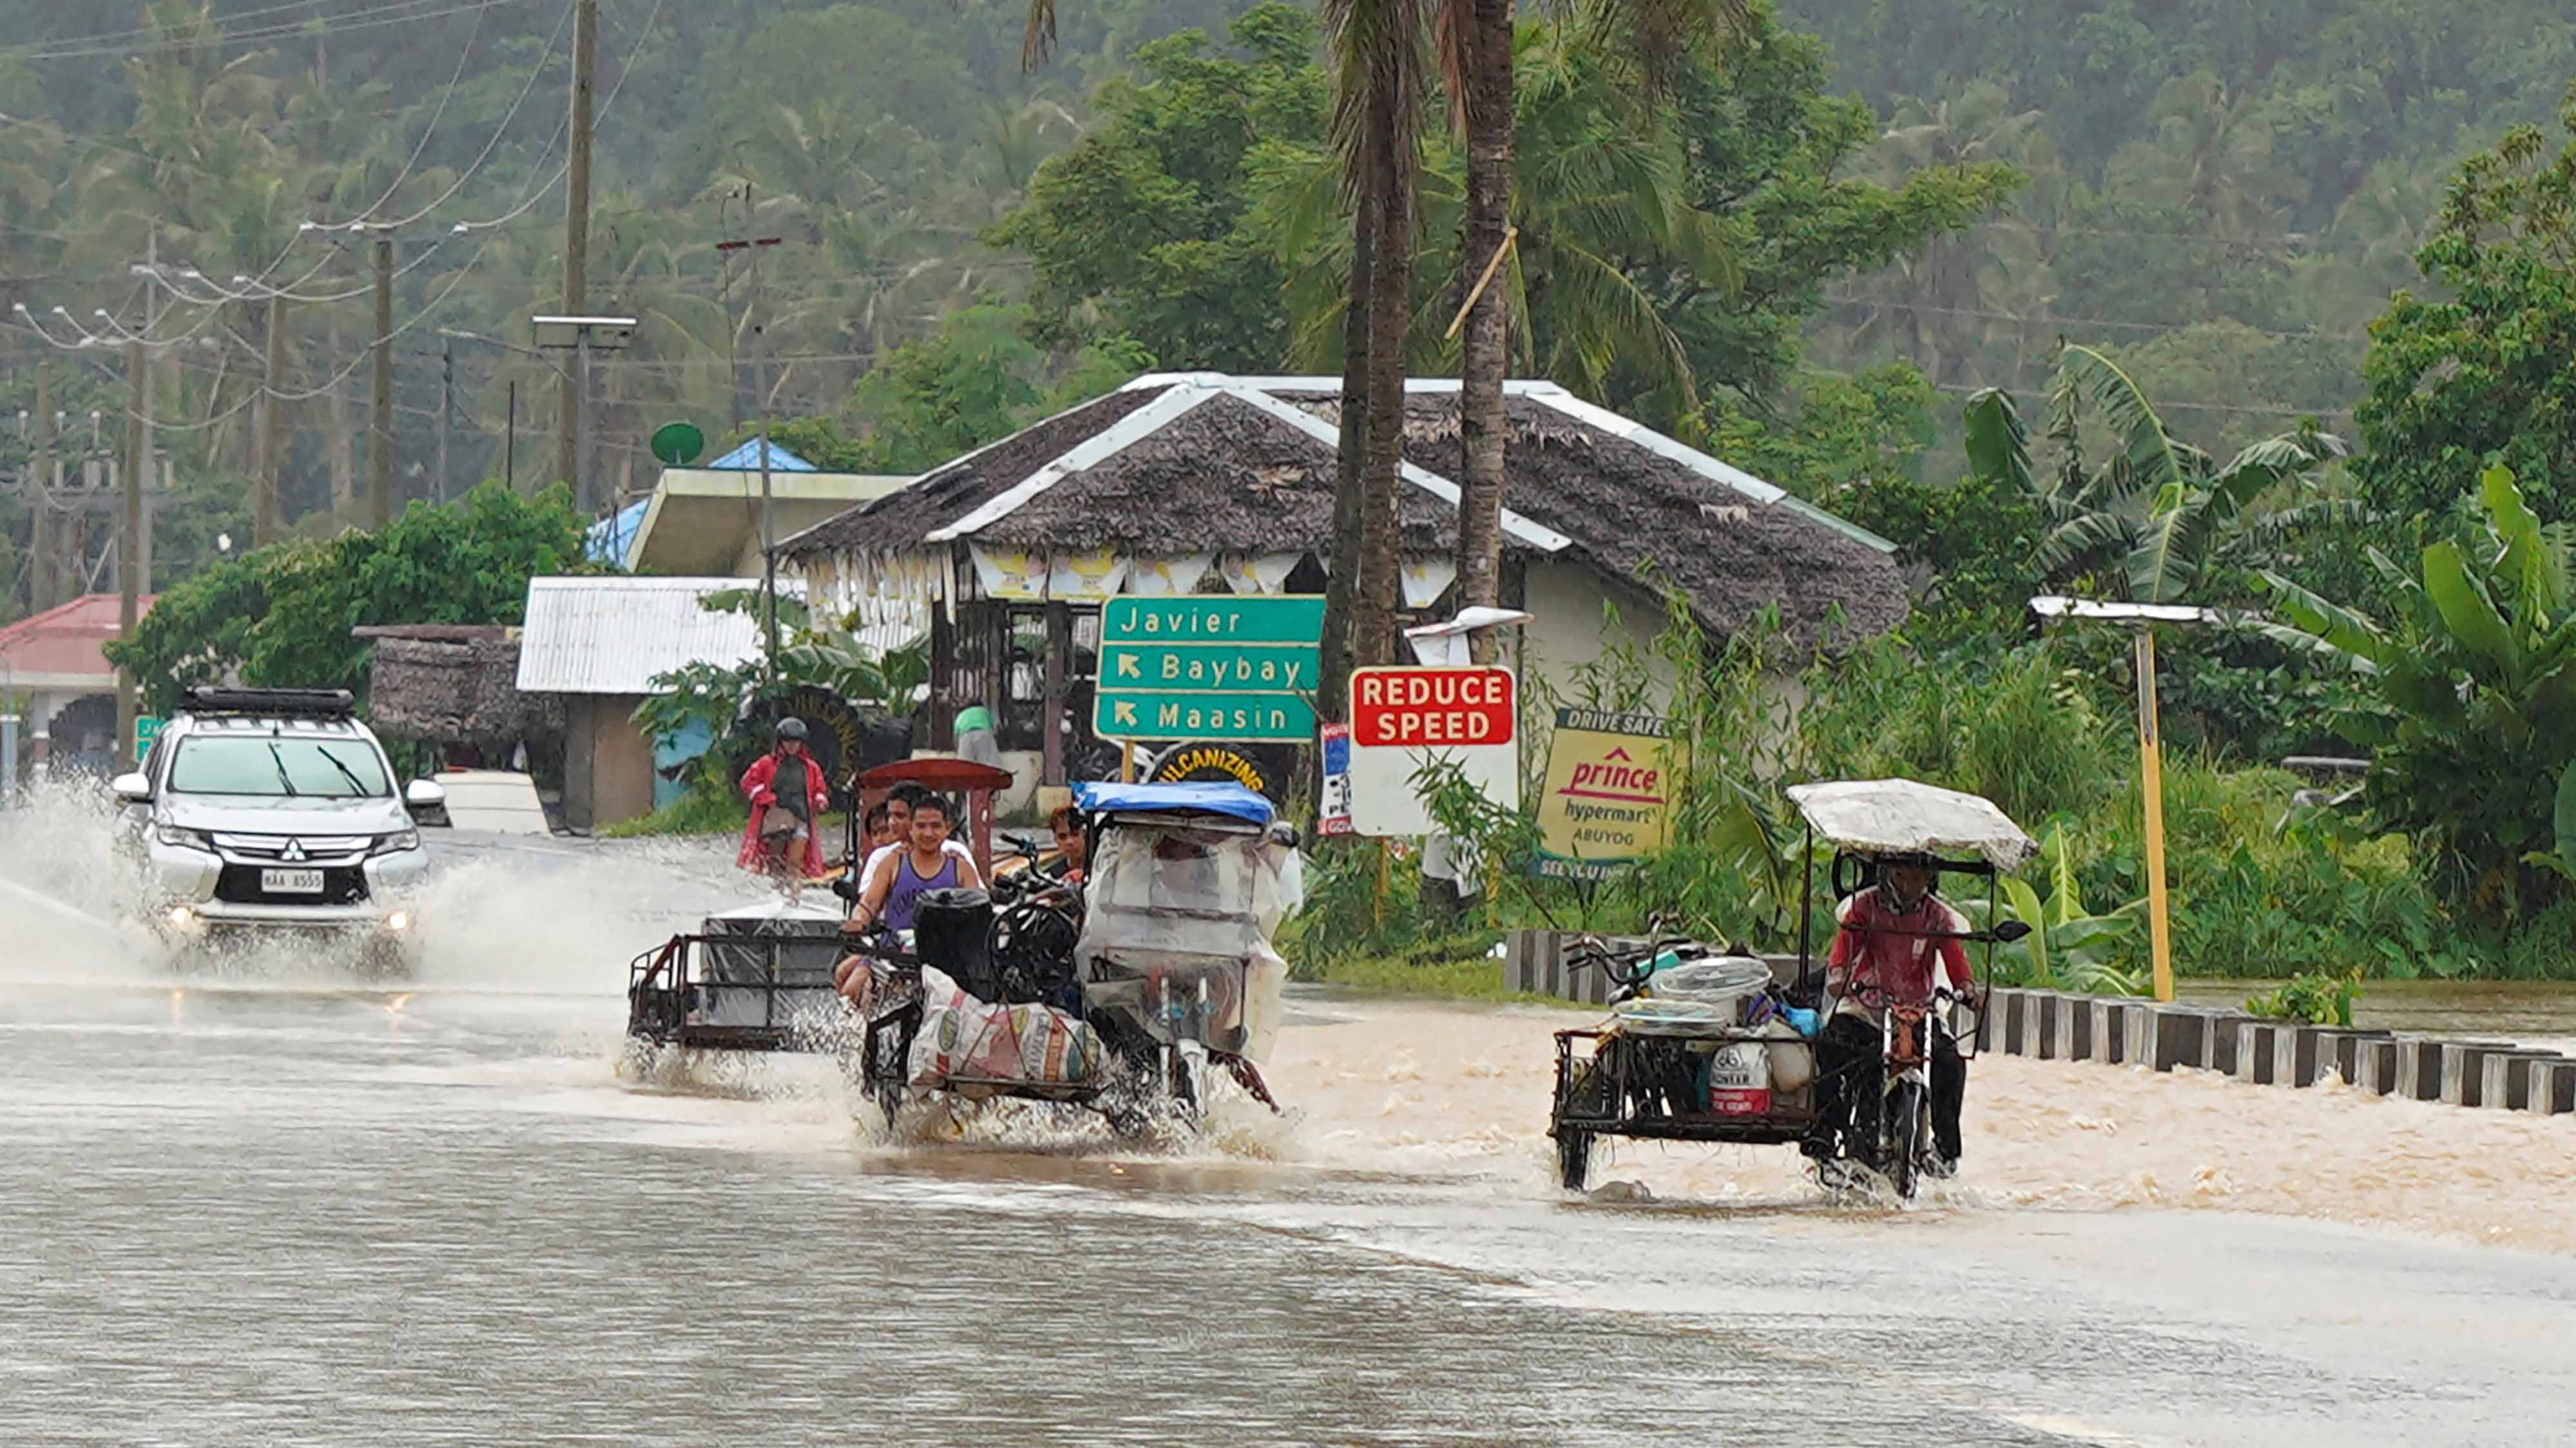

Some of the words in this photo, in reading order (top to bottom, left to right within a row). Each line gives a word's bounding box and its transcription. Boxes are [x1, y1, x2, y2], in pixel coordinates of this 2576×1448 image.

[1120, 607, 1240, 633] Javier
[1161, 653, 1301, 688] Baybay
[1363, 676, 1503, 706] REDUCE
[1157, 703, 1286, 729] Maasin
[1377, 711, 1490, 741] SPEED
[1567, 710, 1620, 731] DRIVE
[1570, 762, 1658, 790] prince
[1573, 828, 1635, 846] ABUYOG
